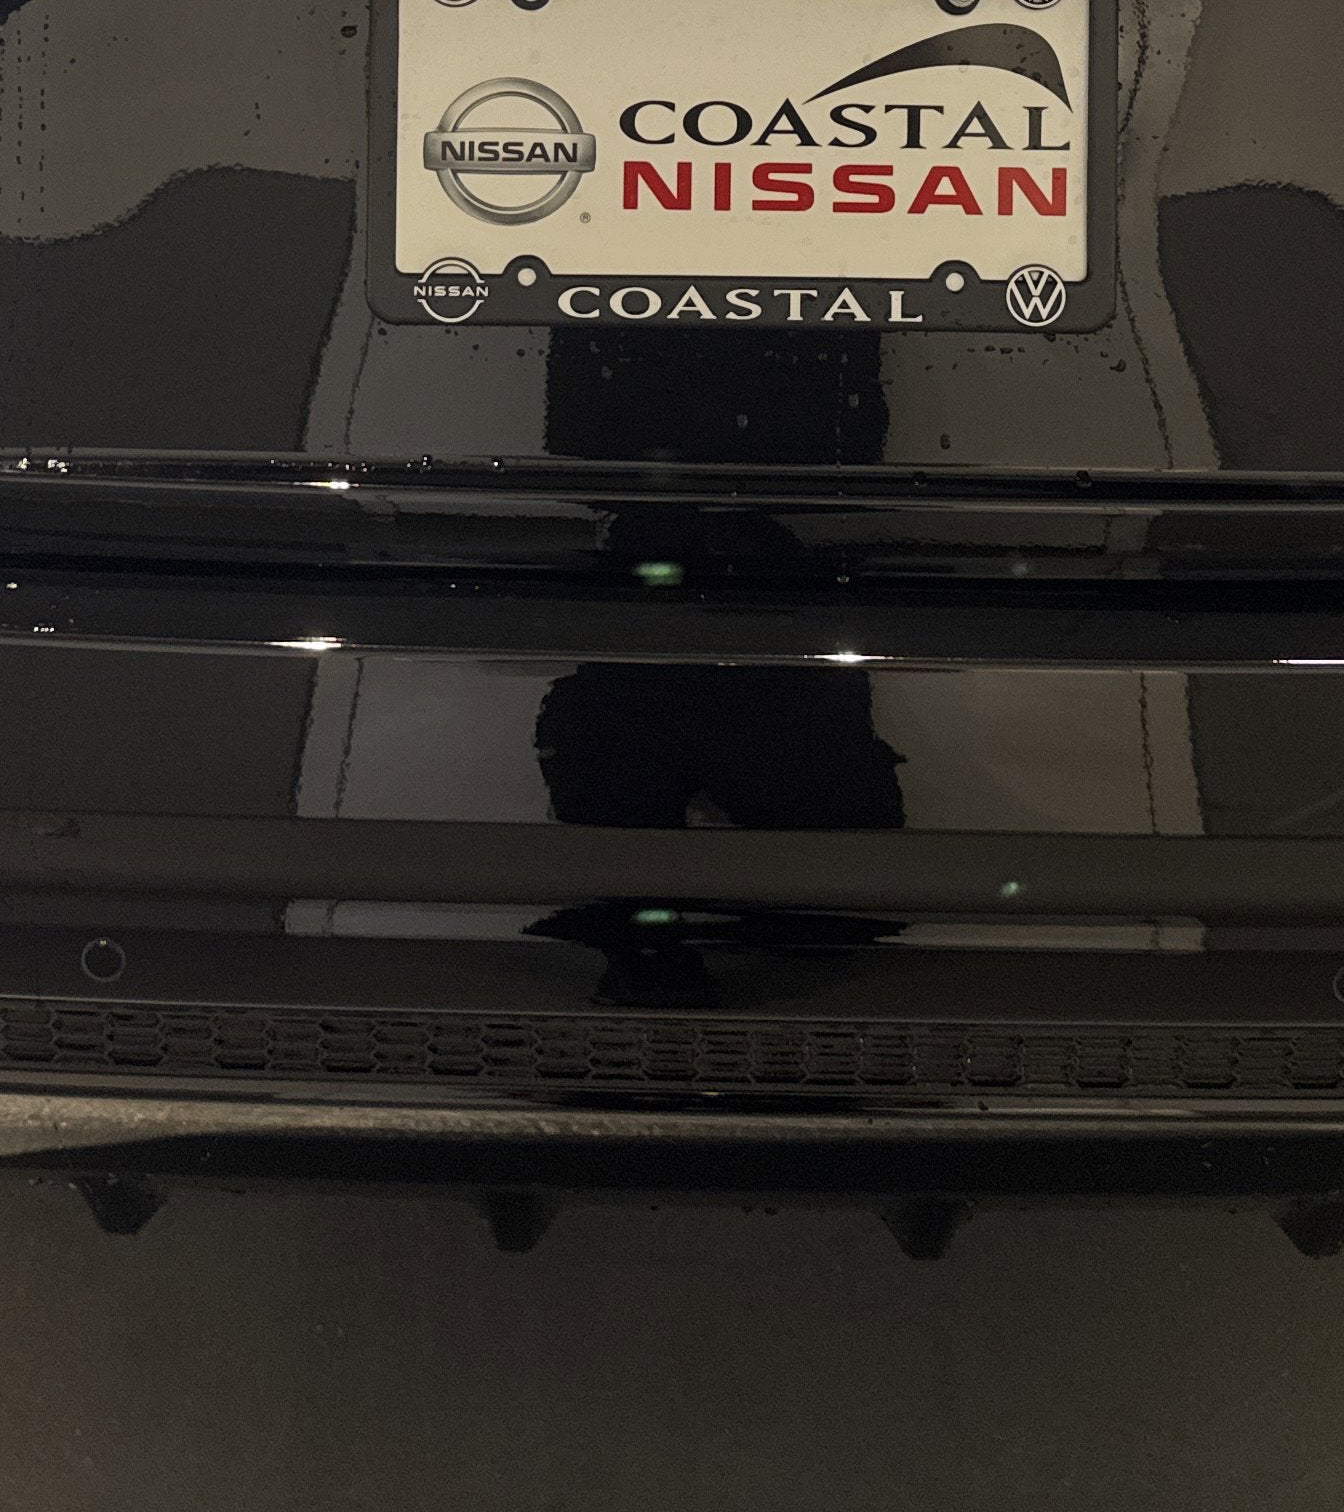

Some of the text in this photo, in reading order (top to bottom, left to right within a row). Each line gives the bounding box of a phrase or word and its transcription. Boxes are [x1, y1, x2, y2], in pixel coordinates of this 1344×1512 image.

[619, 97, 1072, 151] COASTAL
[441, 140, 578, 163] NISSAN
[622, 160, 1067, 217] NISSAN
[413, 284, 489, 297] NISSAN
[557, 284, 924, 324] COASTAL
